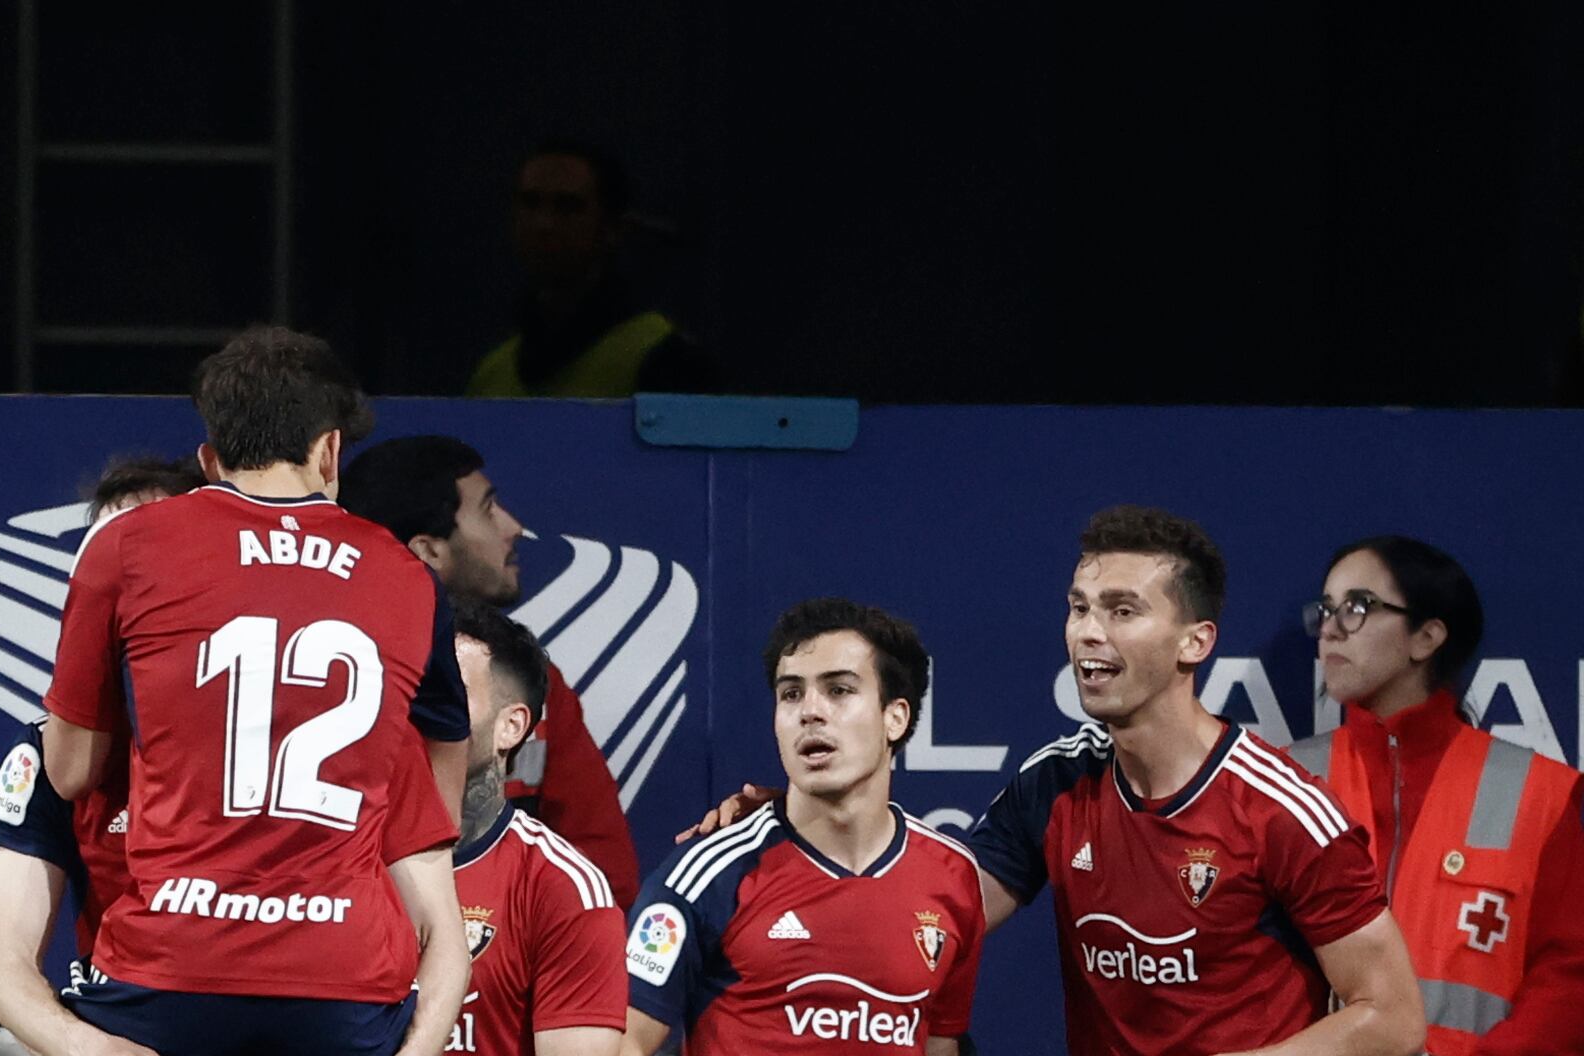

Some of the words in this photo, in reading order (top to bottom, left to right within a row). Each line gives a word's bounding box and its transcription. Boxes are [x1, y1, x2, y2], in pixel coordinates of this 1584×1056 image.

[238, 529, 362, 580] ABDE
[197, 615, 385, 832] 12
[107, 823, 128, 833] adi
[767, 929, 811, 939] adidas
[627, 948, 665, 974] LaLiga
[1081, 941, 1199, 985] verleal
[784, 1000, 920, 1047] verleal
